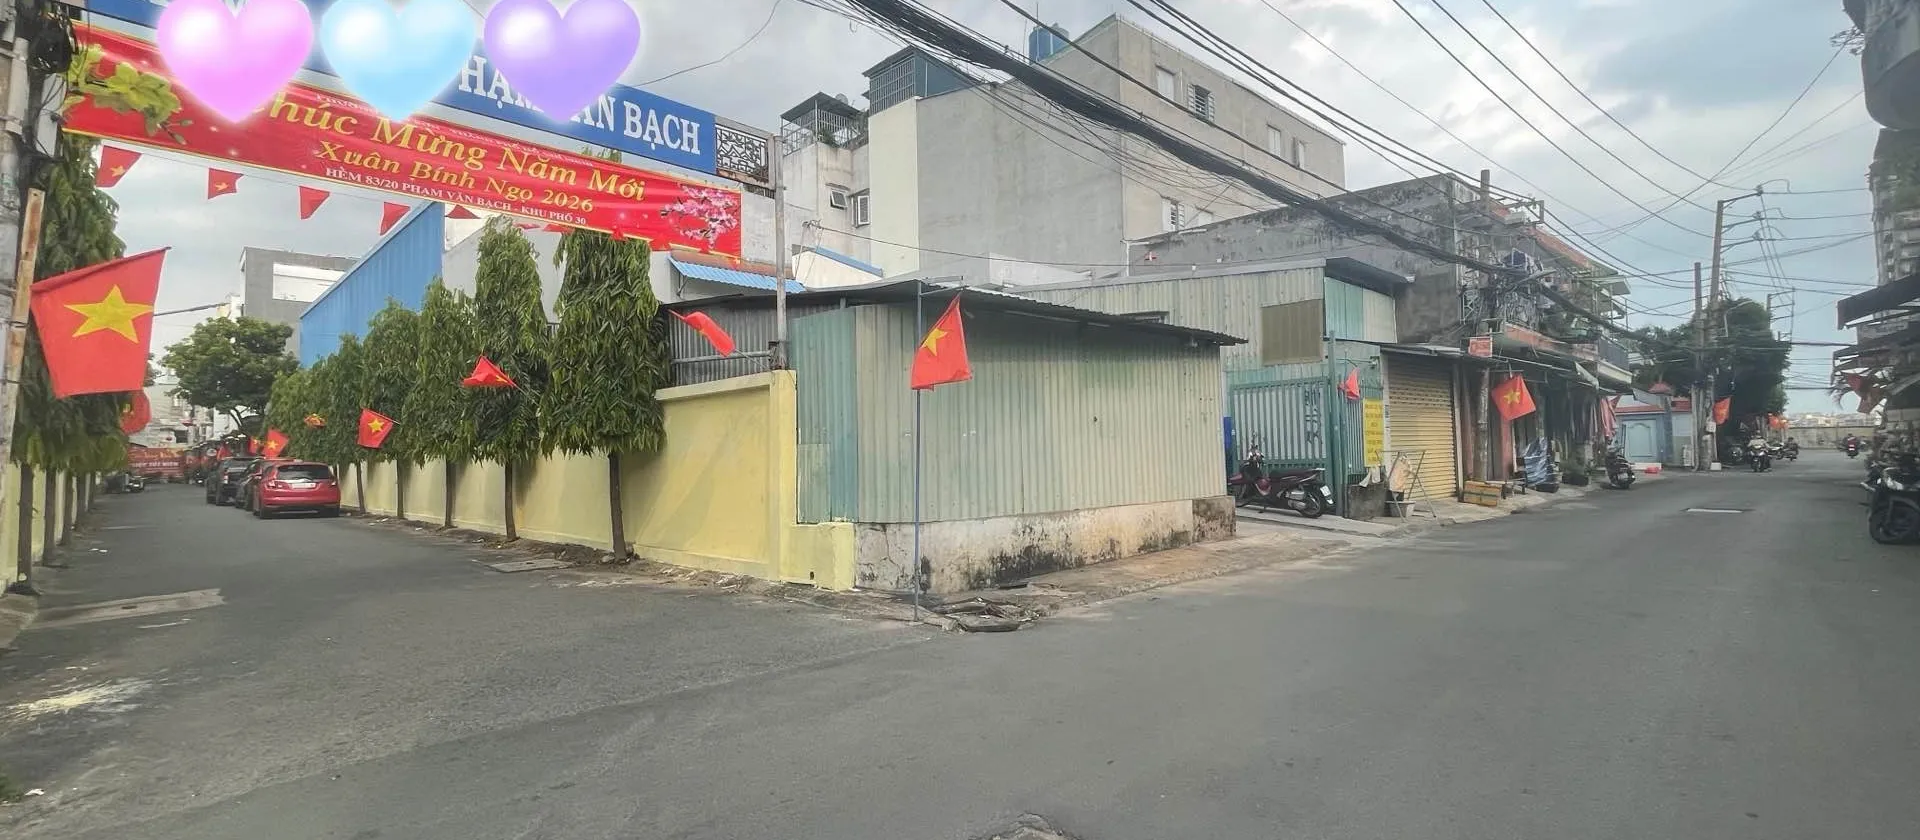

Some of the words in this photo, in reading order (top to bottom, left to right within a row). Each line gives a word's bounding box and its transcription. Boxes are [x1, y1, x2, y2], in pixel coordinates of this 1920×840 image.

[371, 117, 489, 170] Mừng
[496, 147, 577, 187] Năm
[587, 169, 646, 202] Mới
[623, 101, 701, 155] BẠCH
[316, 139, 401, 175] Xuân
[409, 160, 477, 190] Bính
[484, 176, 534, 202] Ngọ
[543, 189, 594, 213] 2026
[365, 175, 399, 190] 83/20
[446, 188, 474, 205] VĂN
[477, 195, 512, 213] BẠCH
[521, 205, 547, 220] KHU
[549, 206, 574, 223] PHỐ
[574, 213, 587, 226] 30
